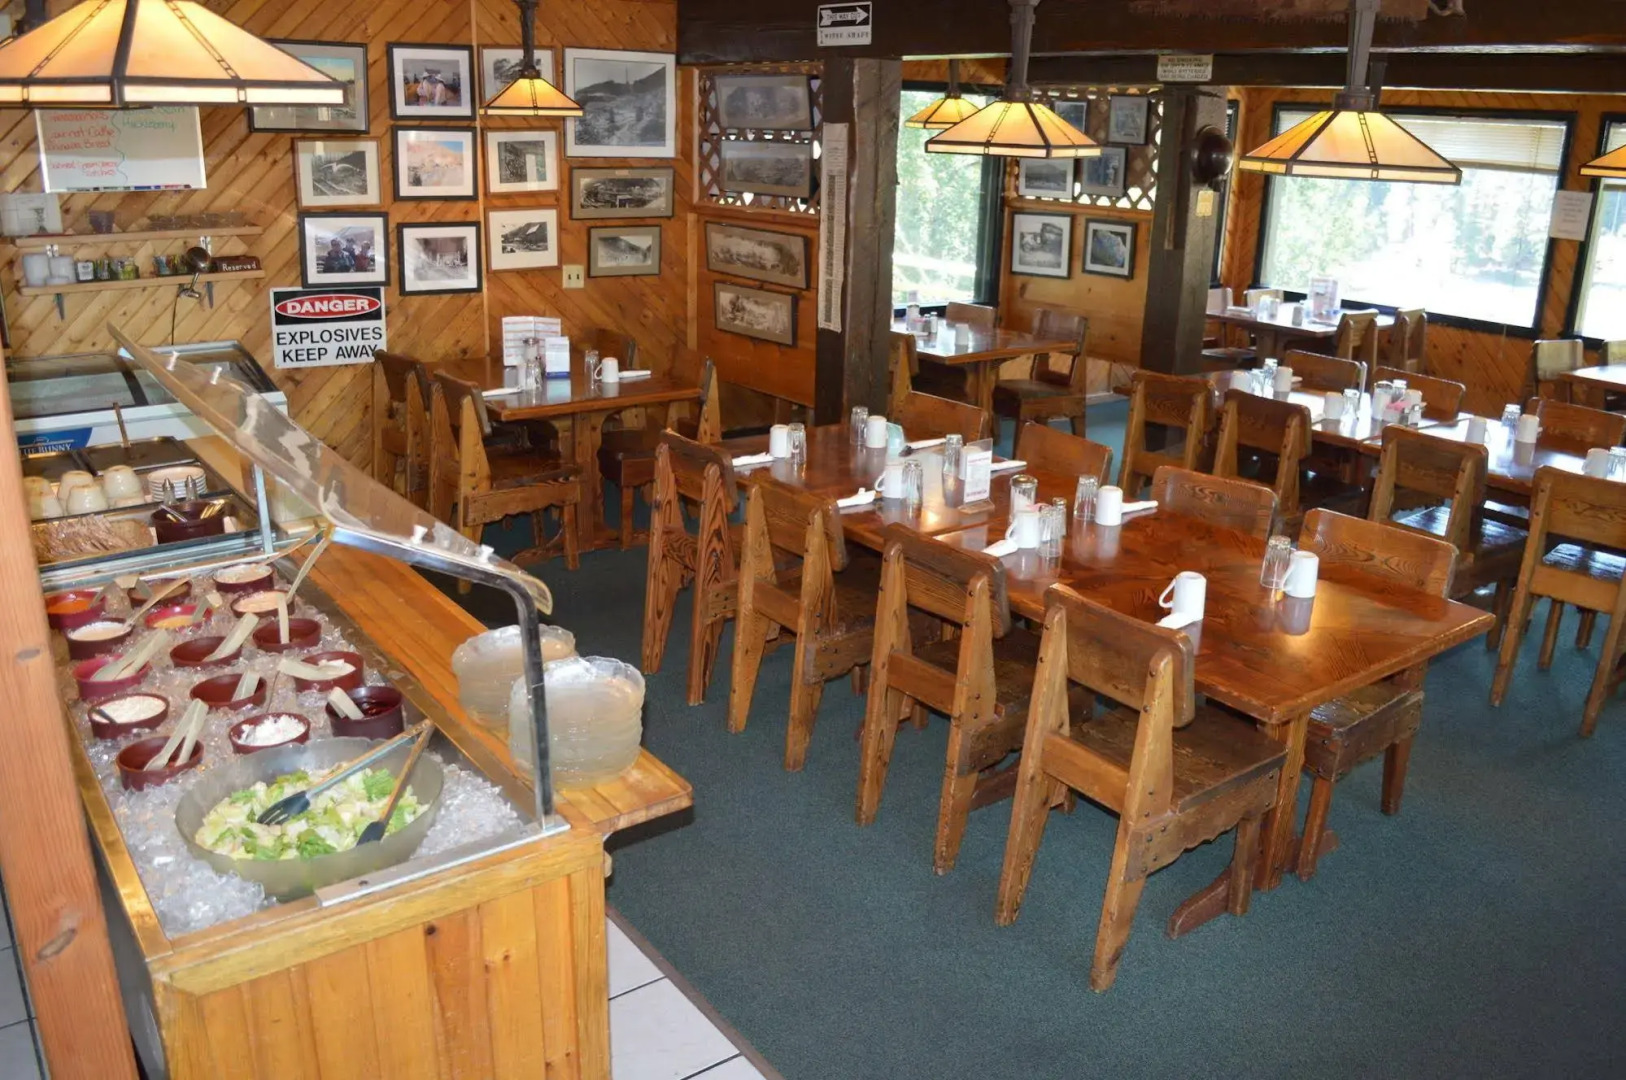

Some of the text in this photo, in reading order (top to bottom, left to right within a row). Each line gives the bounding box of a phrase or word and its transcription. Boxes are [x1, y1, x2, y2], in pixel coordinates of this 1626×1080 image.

[222, 261, 257, 272] Reserved
[286, 299, 370, 314] DANGER
[276, 326, 383, 346] EXPLOSIVES
[282, 344, 378, 363] KEEP AWAY
[38, 443, 72, 454] BUNNY
